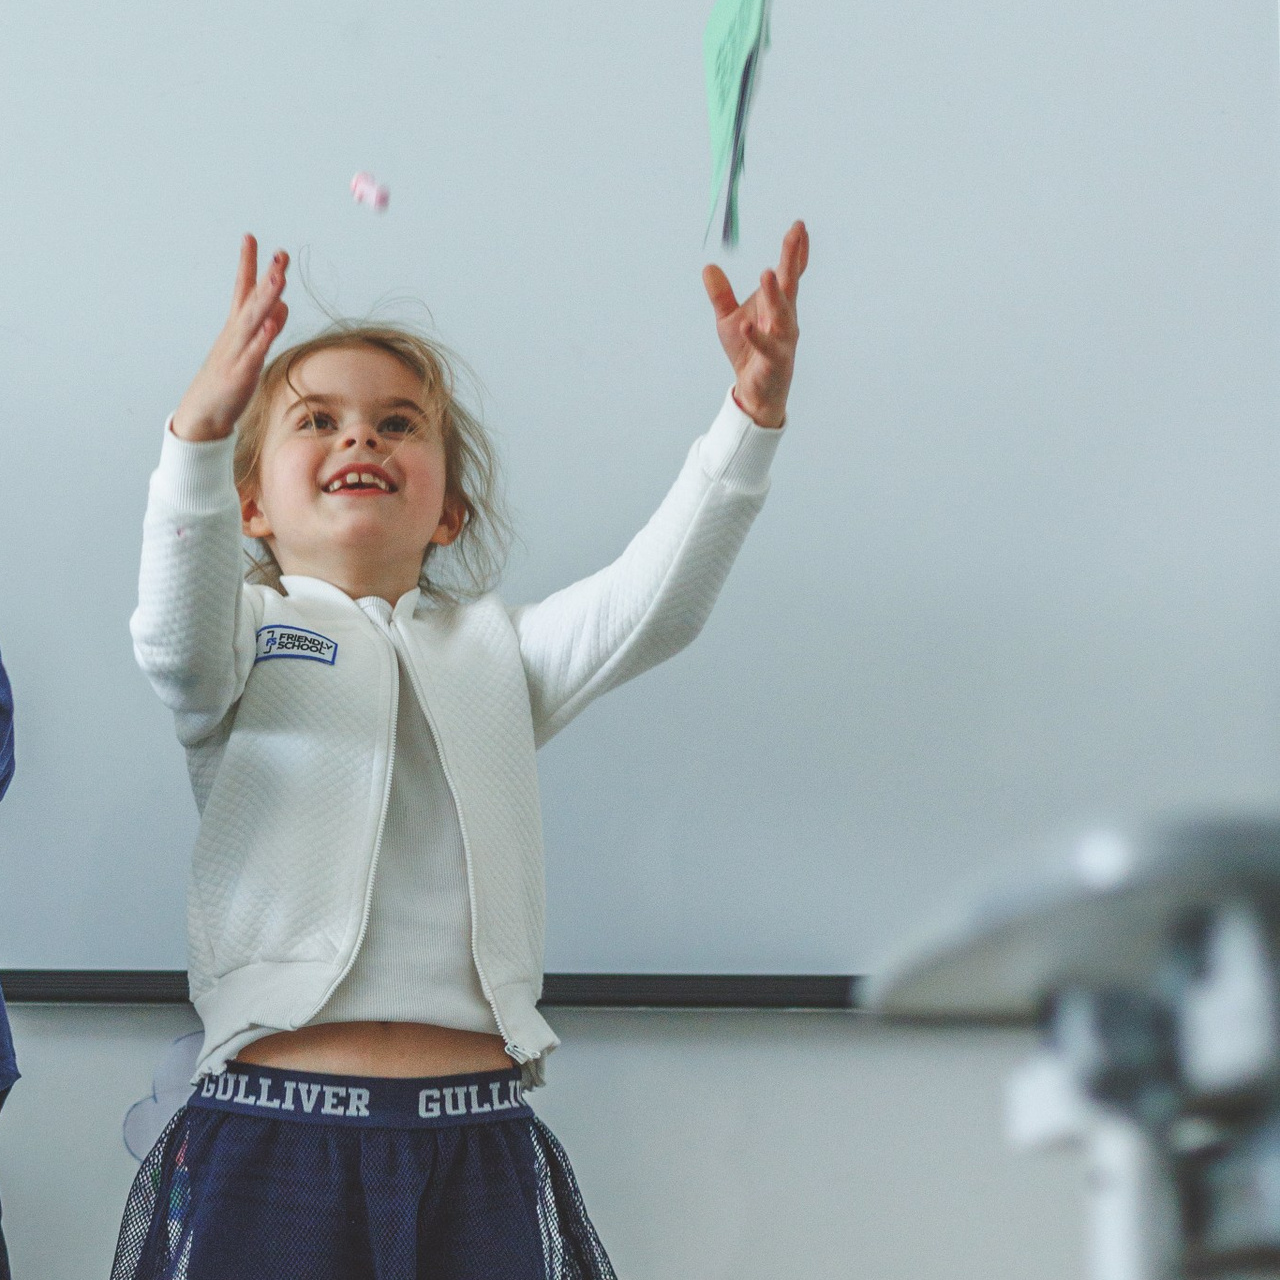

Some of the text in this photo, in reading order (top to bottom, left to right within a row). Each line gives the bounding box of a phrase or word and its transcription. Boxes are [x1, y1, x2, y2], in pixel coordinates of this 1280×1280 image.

[277, 641, 325, 655] SCHOOL
[279, 633, 333, 650] FRIENDLY
[201, 1073, 370, 1117] GULLIVER
